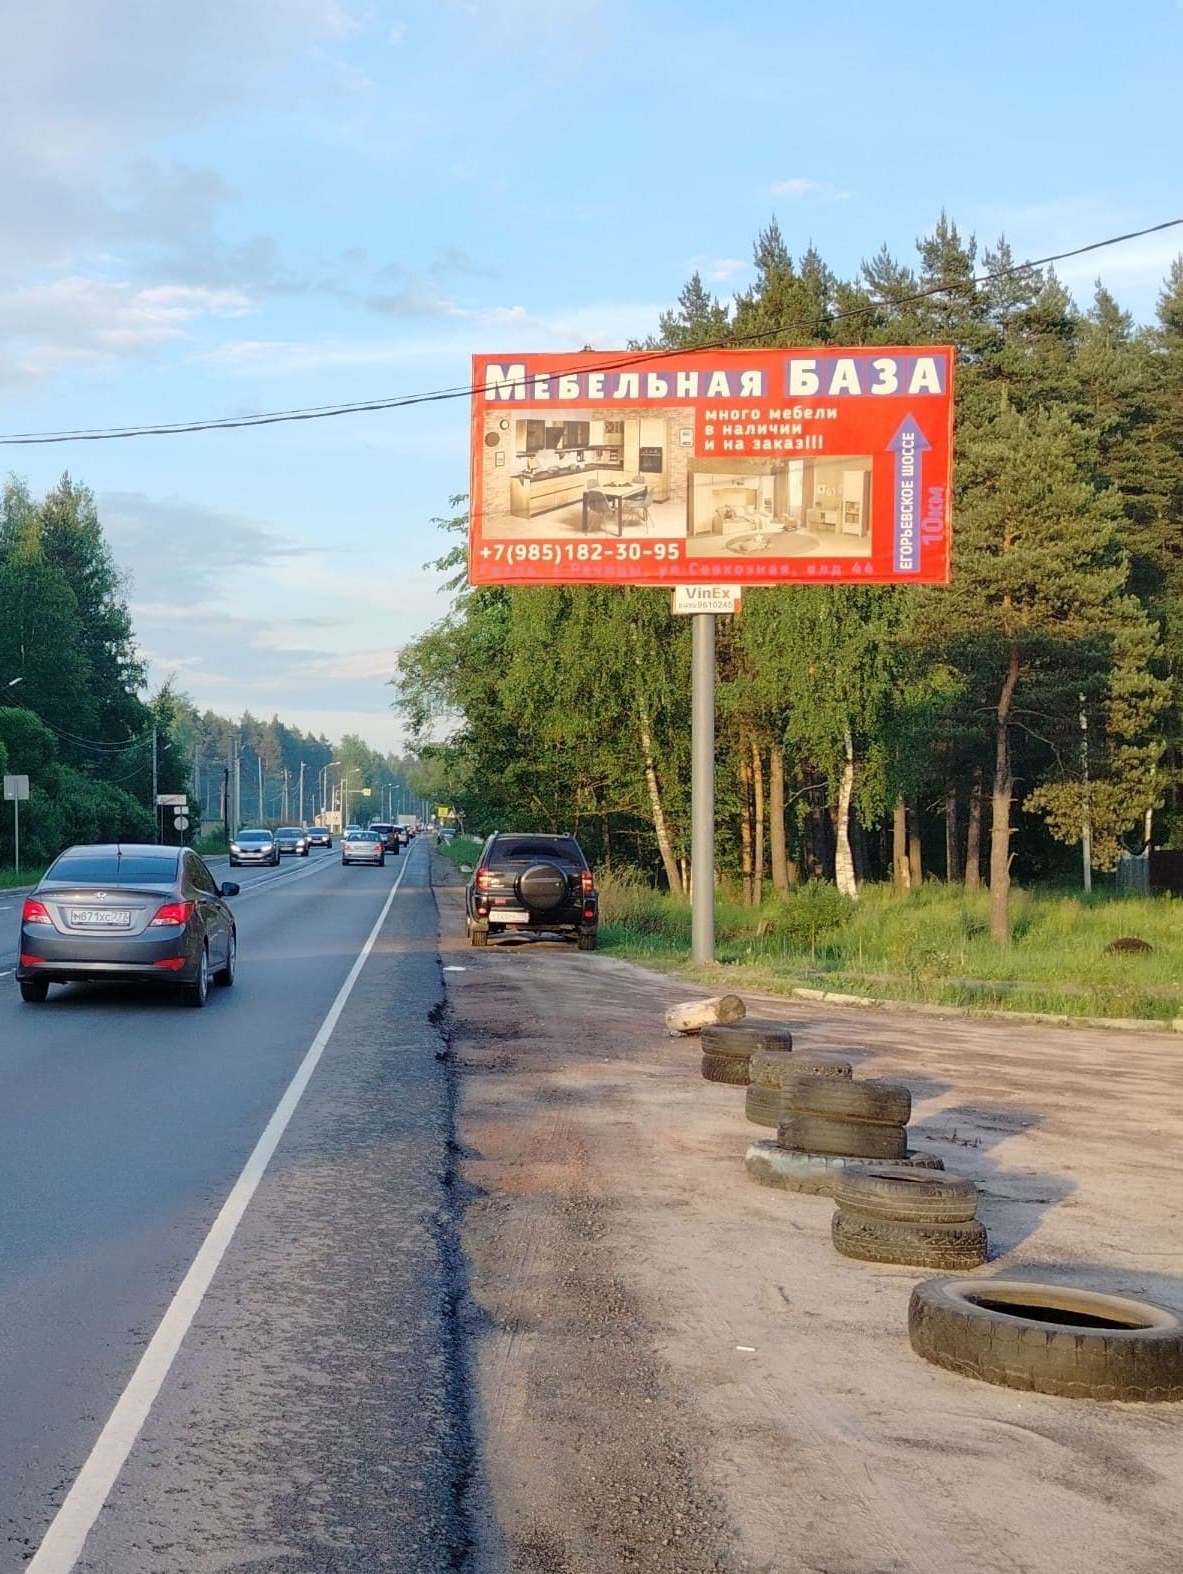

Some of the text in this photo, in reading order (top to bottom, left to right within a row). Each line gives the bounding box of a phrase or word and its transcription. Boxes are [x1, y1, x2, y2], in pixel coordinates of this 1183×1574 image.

[789, 357, 942, 396] БАЗА
[705, 405, 838, 421] много мебели
[704, 423, 803, 436] в наличии
[704, 434, 824, 451] и на заказ!!!
[899, 432, 915, 570] ЕГОРЬЕВСКОЕ ШОССЕ
[480, 543, 680, 565] +7(985)182-30-95
[685, 587, 730, 599] VinEx
